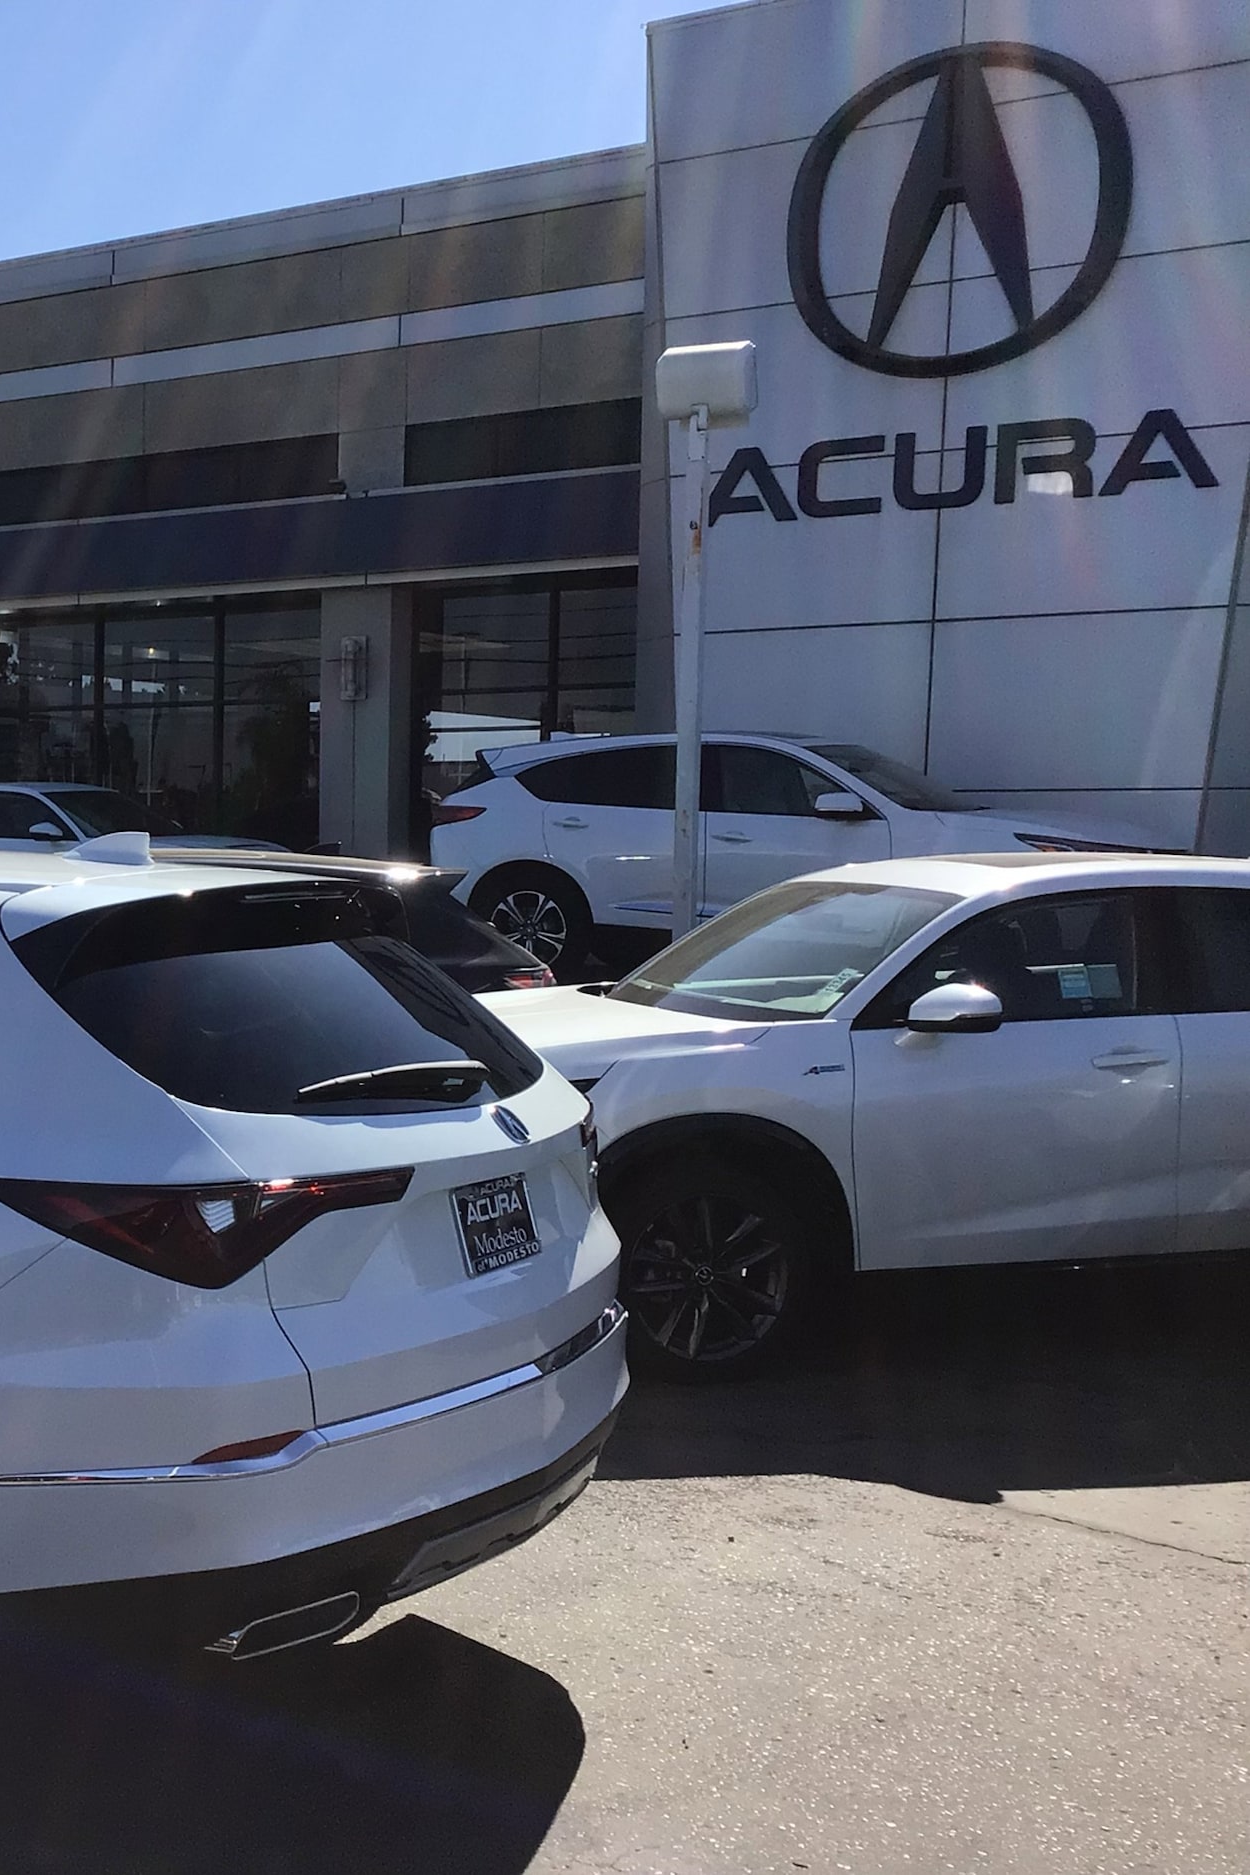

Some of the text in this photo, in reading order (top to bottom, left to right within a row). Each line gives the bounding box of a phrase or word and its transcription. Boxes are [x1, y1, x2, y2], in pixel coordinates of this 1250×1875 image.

[708, 408, 1219, 527] ACURA
[467, 1190, 523, 1225] ACURA
[473, 1226, 527, 1256] Modesto
[489, 1241, 539, 1269] MODESTO
